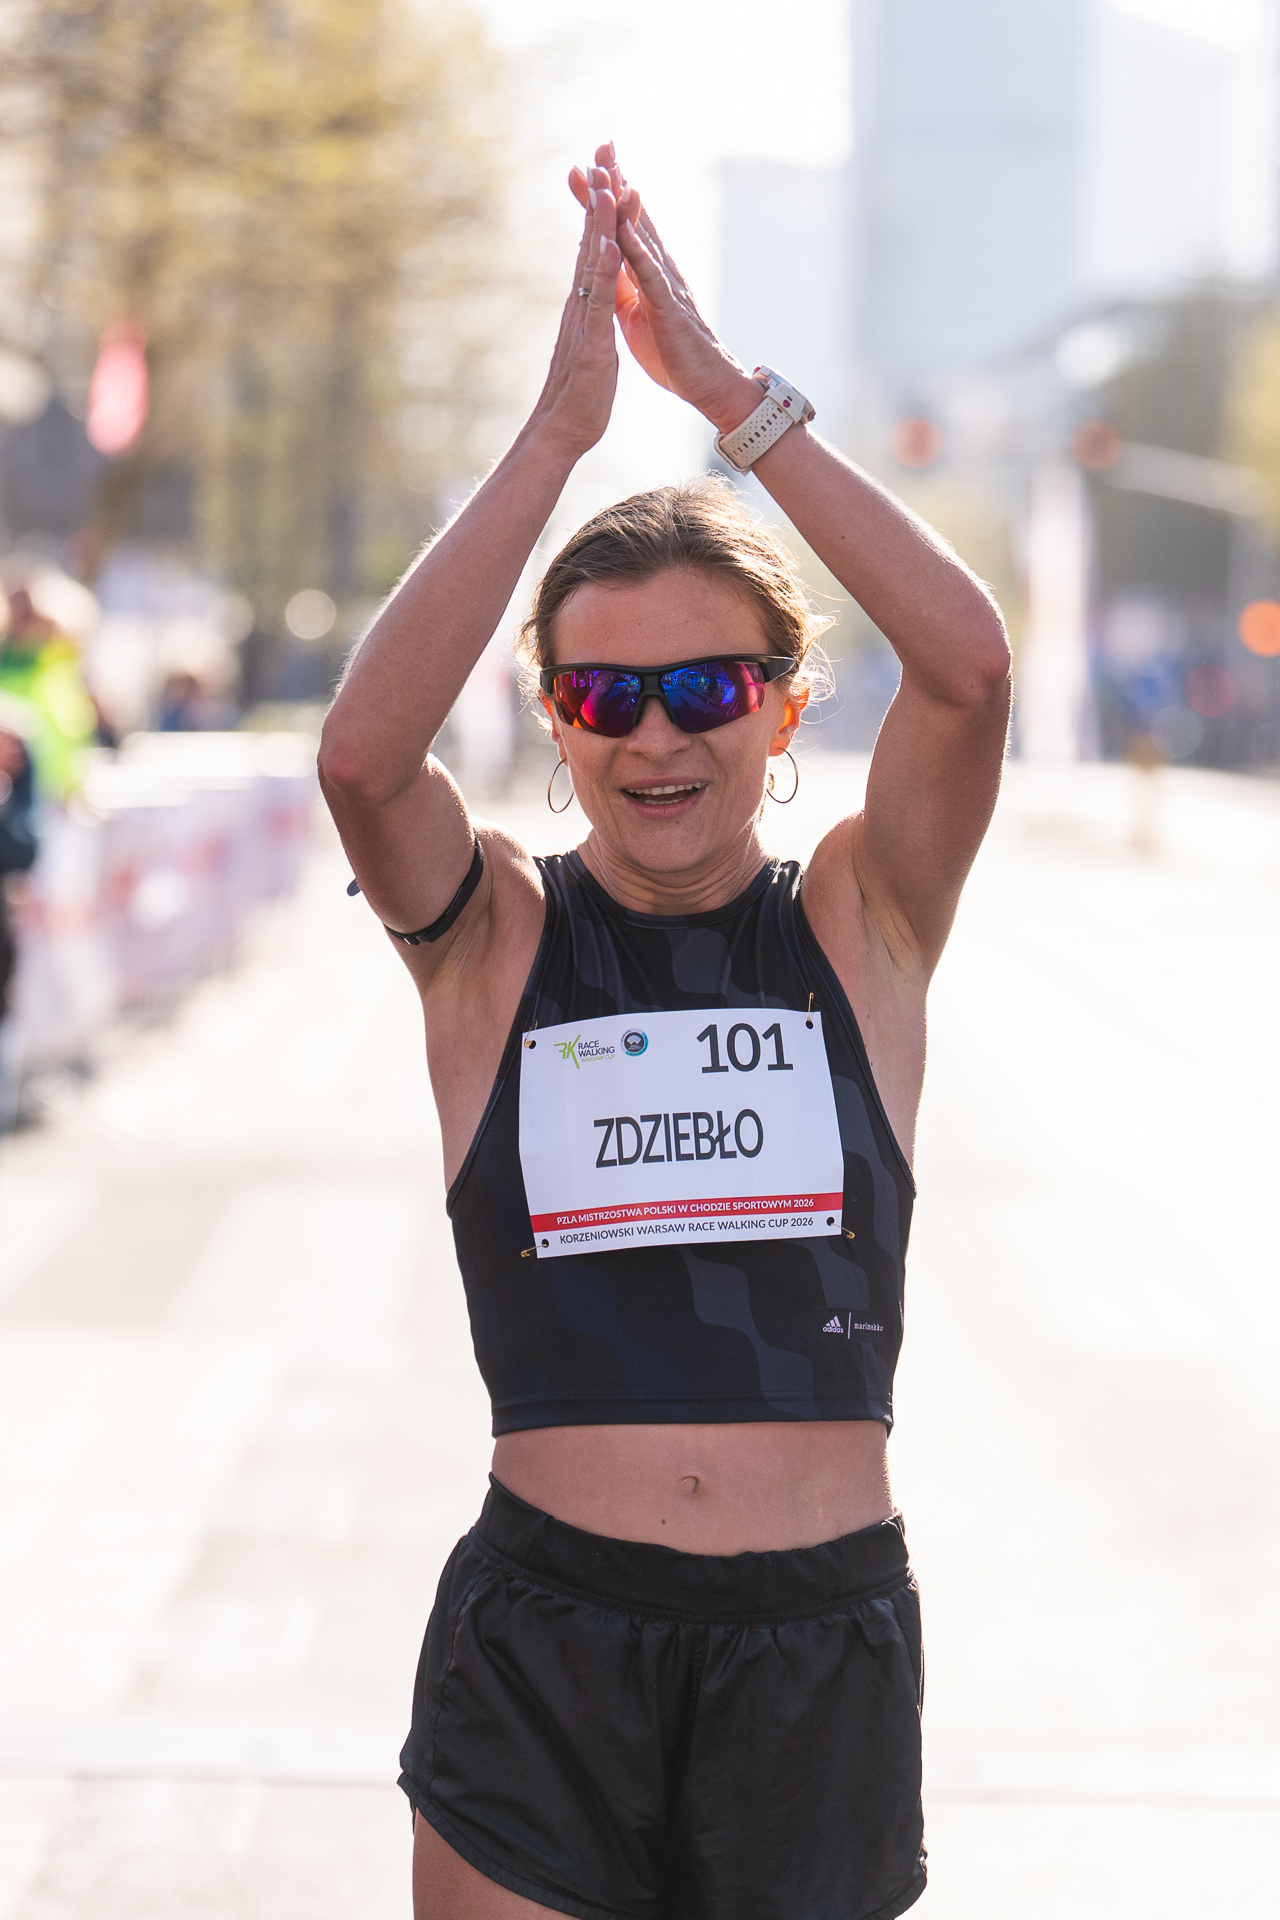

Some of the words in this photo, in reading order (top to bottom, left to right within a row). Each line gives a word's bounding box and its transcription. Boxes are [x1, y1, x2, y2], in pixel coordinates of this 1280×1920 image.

[578, 1040, 599, 1049] RACE
[578, 1046, 615, 1057] WALKING
[696, 1023, 793, 1073] 101
[593, 1108, 764, 1168] ZDZIEBŁO
[556, 1215, 578, 1225] PZLA
[578, 1208, 643, 1222] MISTRZOSTWA
[643, 1205, 677, 1215] POLSKI
[678, 1204, 689, 1213] W
[689, 1201, 731, 1212] CHODZIE
[732, 1199, 792, 1211] SPORTOWYM
[793, 1198, 814, 1208] 2026
[559, 1227, 635, 1244] KORZENIOWSKI
[636, 1223, 686, 1235] WARSAW
[688, 1221, 716, 1233] RACE
[717, 1219, 766, 1231] WALKING
[768, 1218, 789, 1228] CUP
[790, 1216, 814, 1227] 2026
